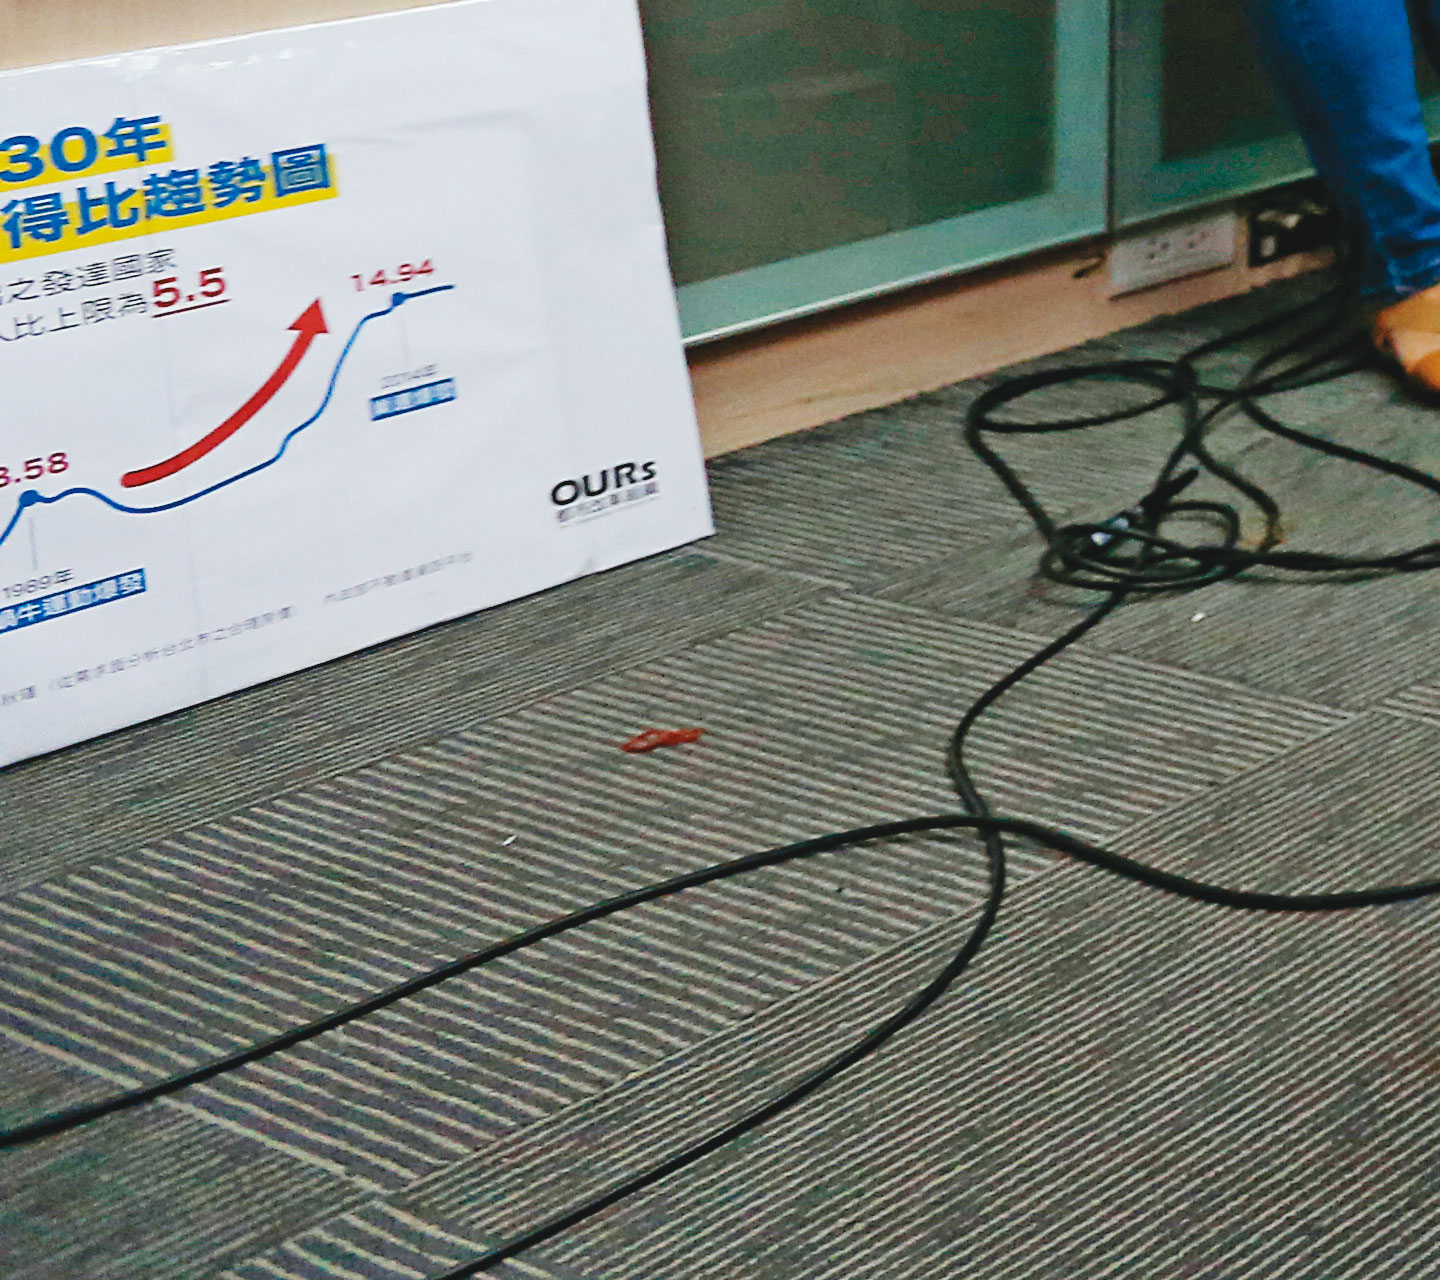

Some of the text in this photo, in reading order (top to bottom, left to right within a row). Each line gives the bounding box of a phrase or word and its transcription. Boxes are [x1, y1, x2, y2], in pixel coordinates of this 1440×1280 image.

[1, 143, 330, 248] 得比趨勢圖
[0, 248, 177, 306] 之發達國家
[152, 267, 226, 308] 5.5
[350, 259, 434, 291] 14.94
[551, 461, 657, 506] OURs
